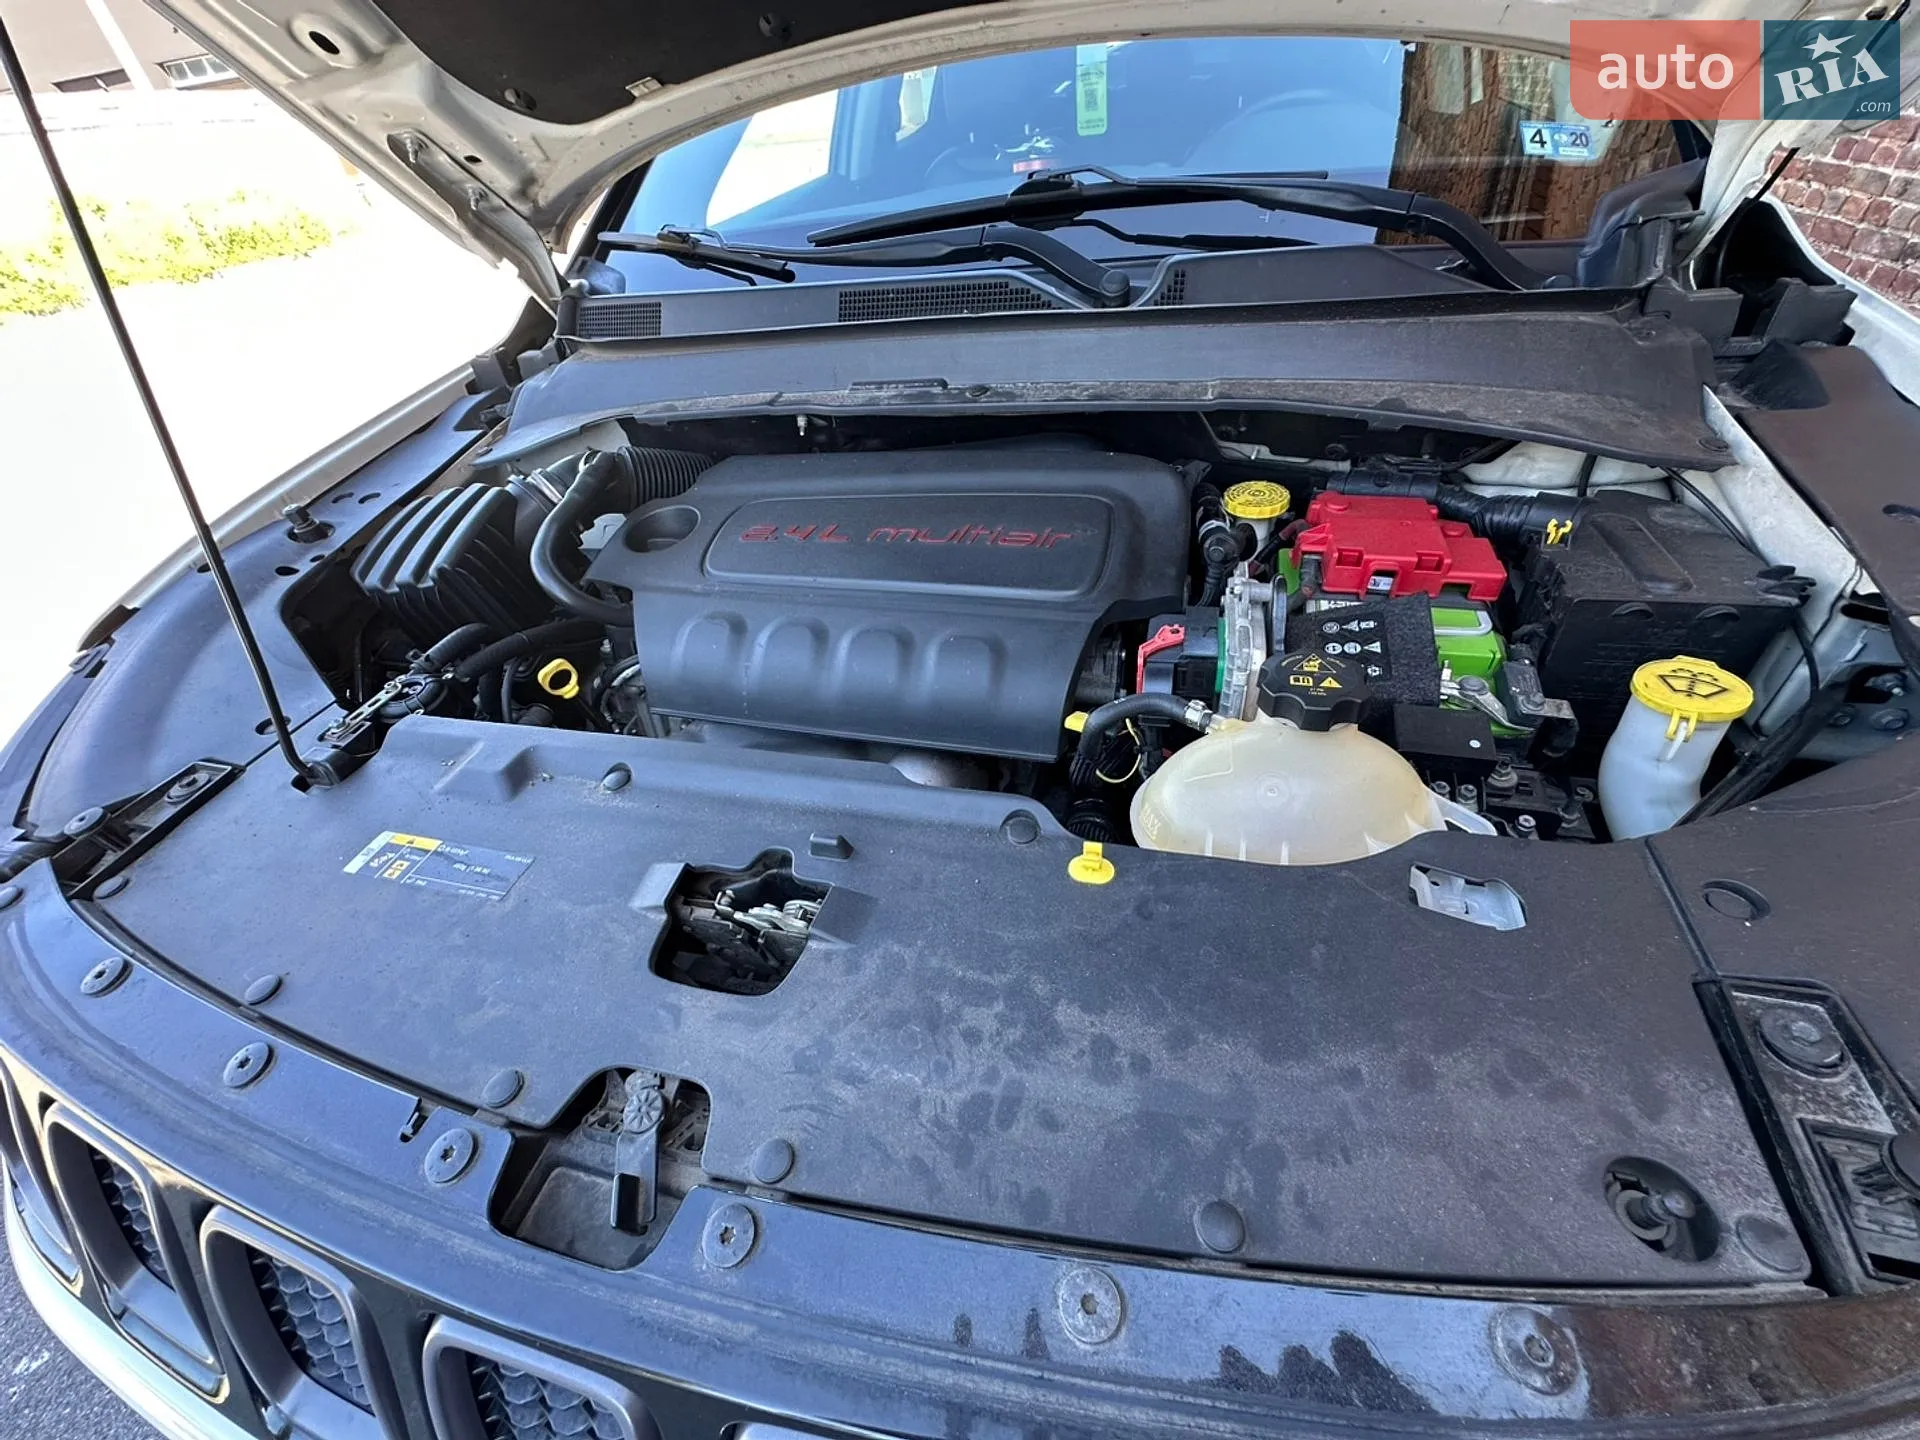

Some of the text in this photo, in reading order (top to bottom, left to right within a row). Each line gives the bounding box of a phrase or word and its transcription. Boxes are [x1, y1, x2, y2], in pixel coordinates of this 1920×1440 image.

[1529, 128, 1589, 148] 4 20
[866, 524, 1073, 549] multiair
